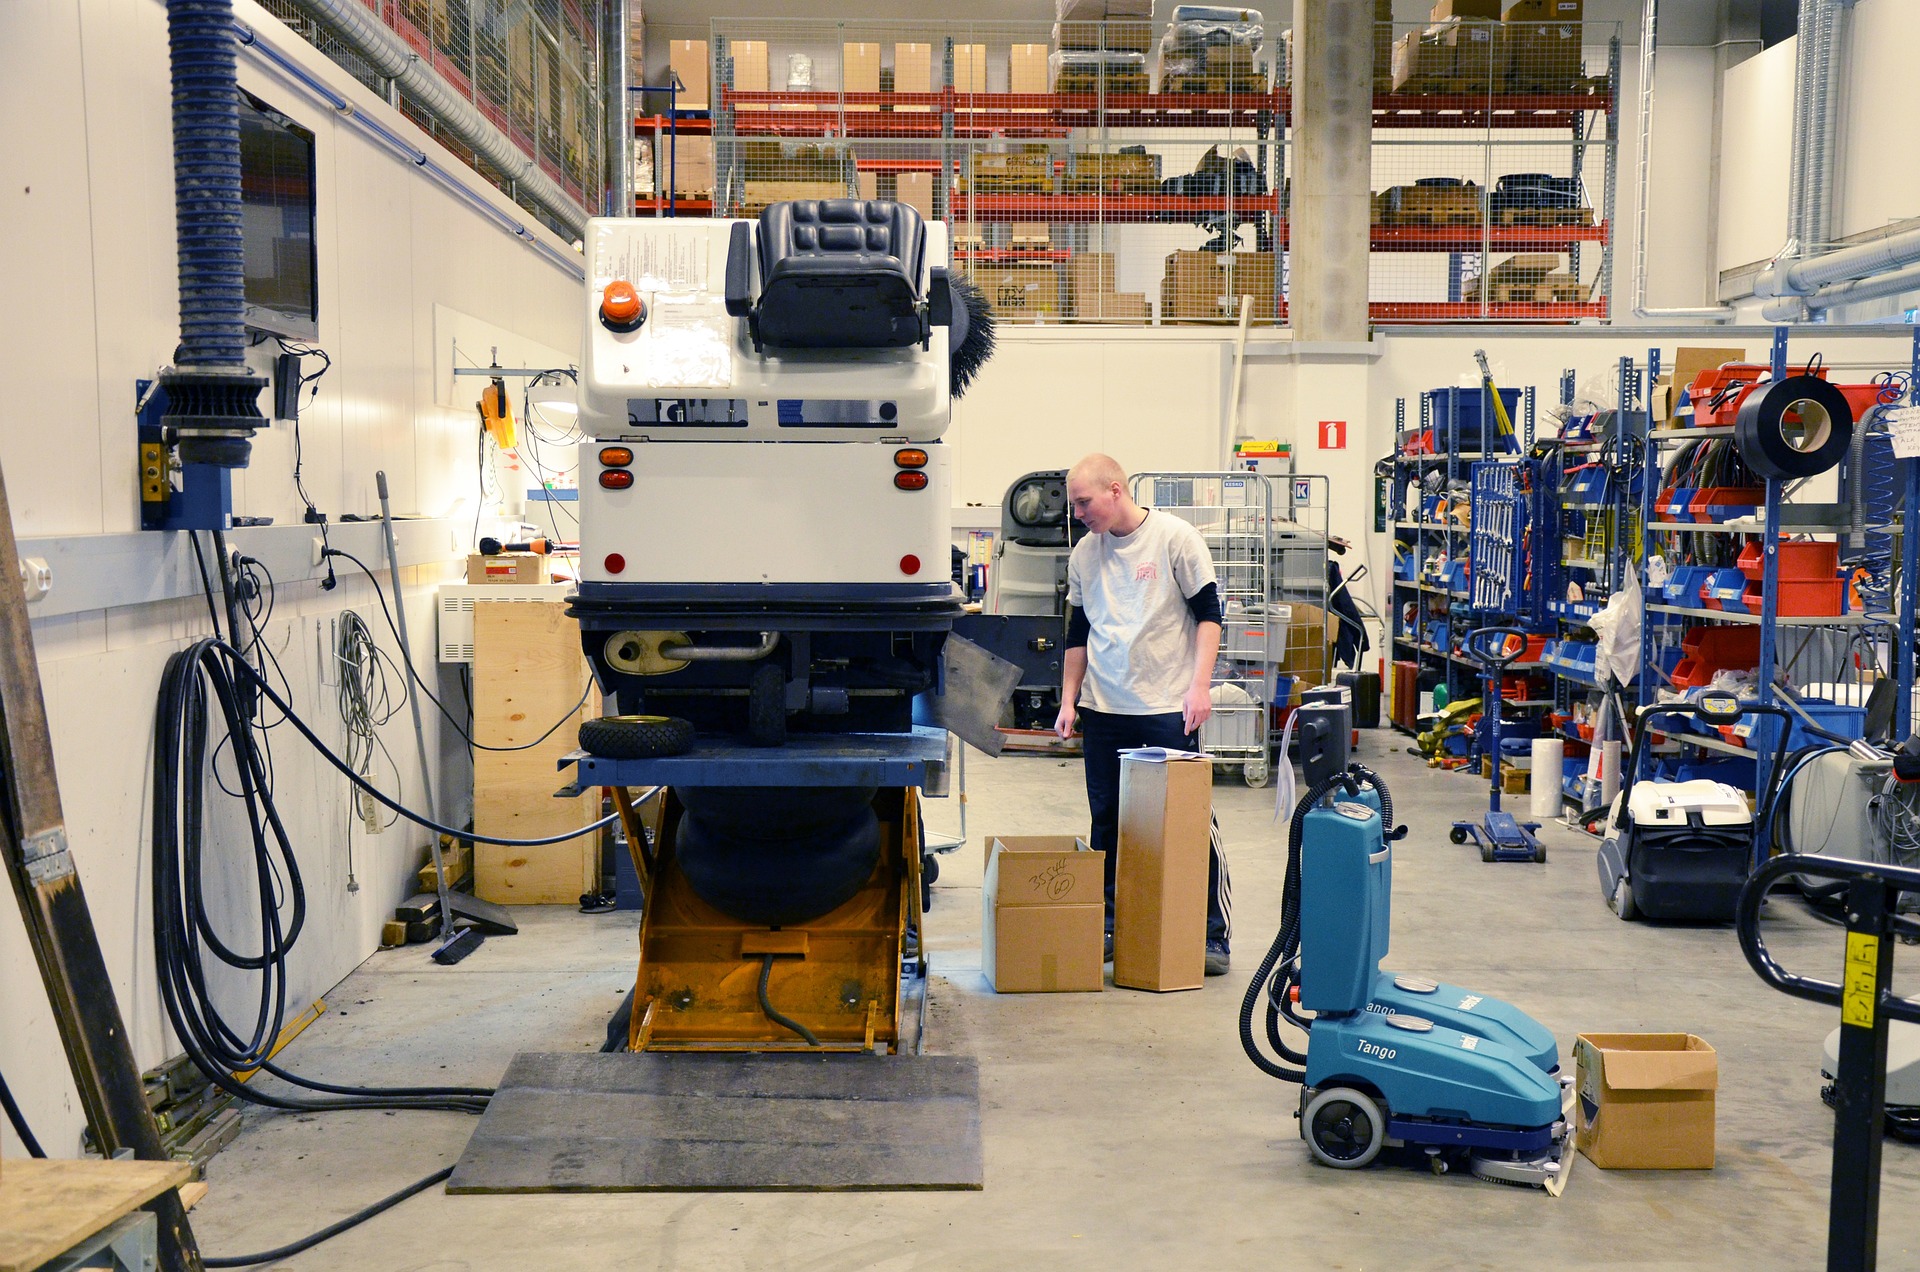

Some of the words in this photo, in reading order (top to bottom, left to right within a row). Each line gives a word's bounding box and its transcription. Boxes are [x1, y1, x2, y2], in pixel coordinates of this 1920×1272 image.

[1296, 484, 1307, 499] K
[1366, 1001, 1396, 1016] ango
[1359, 1039, 1397, 1060] Tango
